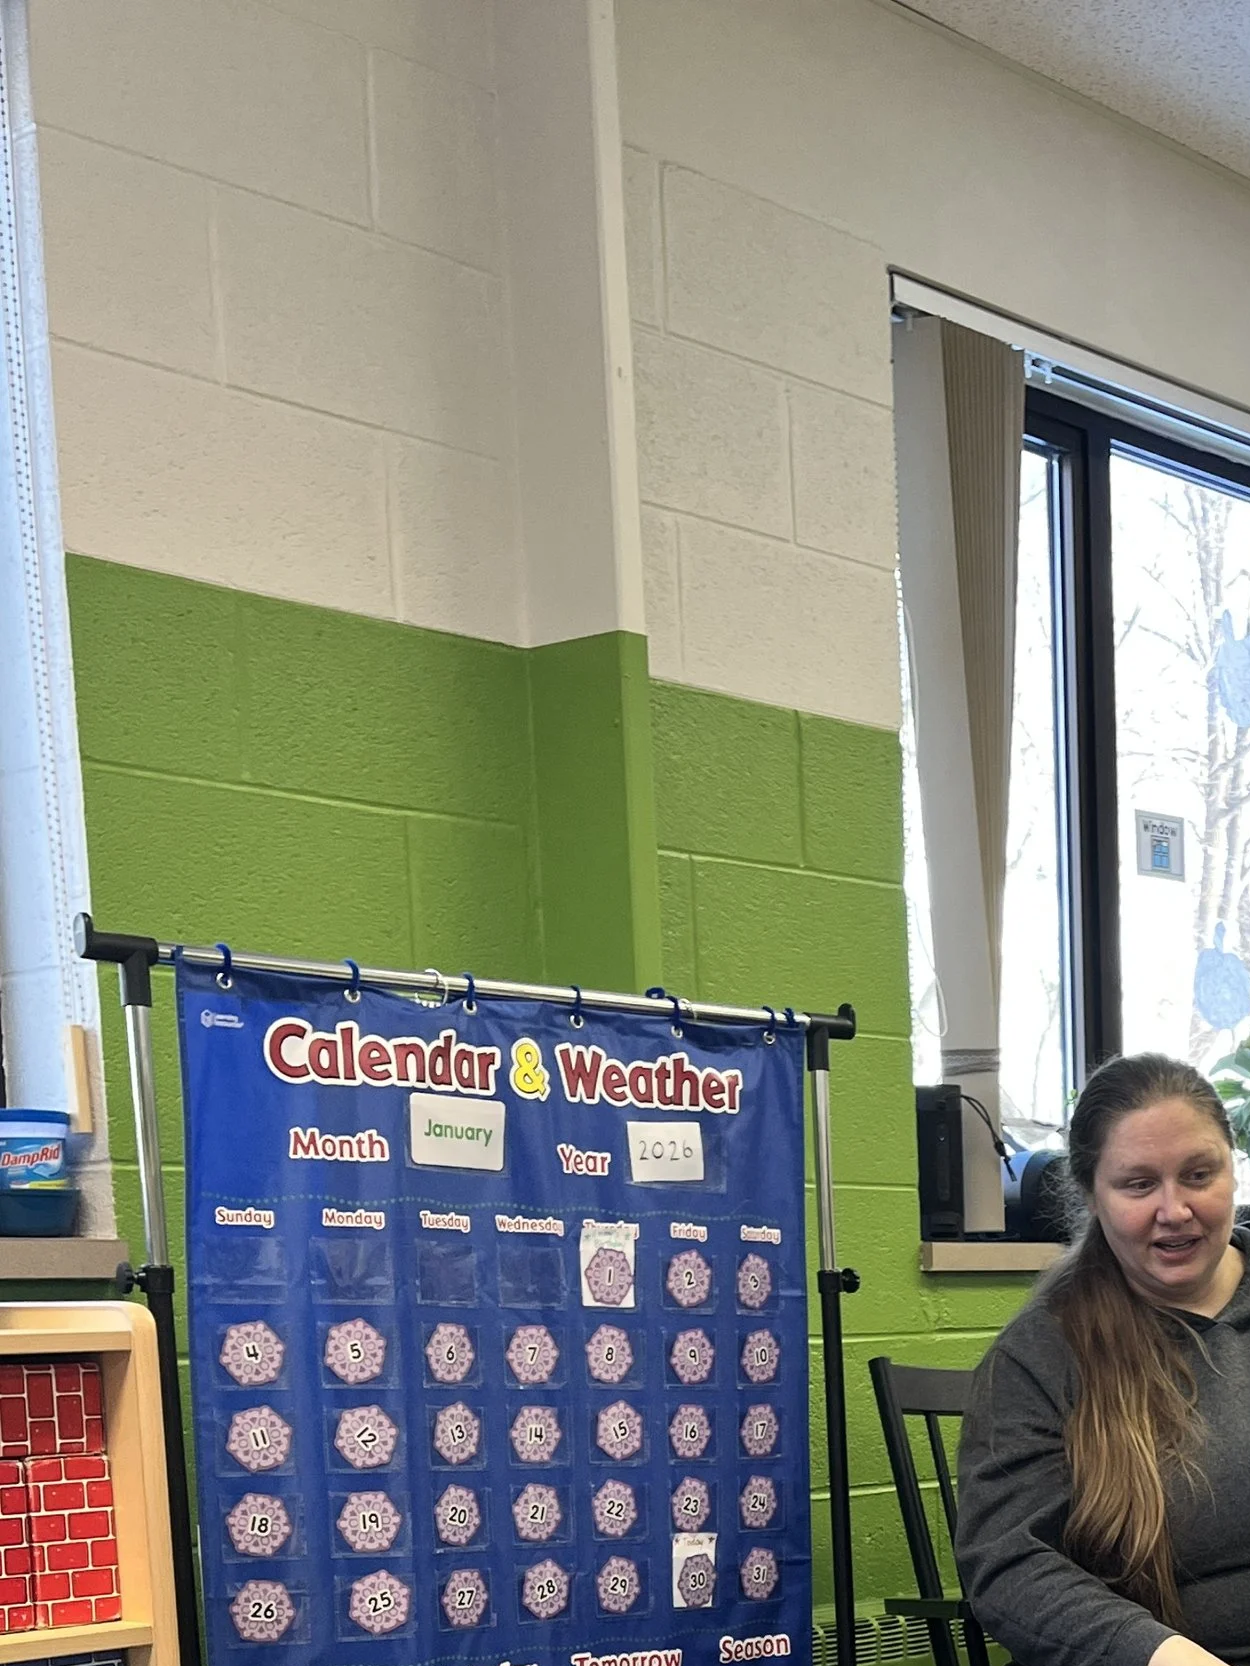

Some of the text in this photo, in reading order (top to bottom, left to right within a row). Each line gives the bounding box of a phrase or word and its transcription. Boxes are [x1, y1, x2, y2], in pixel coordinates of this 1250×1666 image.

[268, 1022, 740, 1111] Calendar & Weather
[291, 1129, 387, 1160] Month
[424, 1119, 493, 1147] January
[1, 1144, 60, 1167] DampRid
[560, 1147, 609, 1174] Year
[639, 1140, 693, 1161] 2026
[217, 1209, 272, 1227] Sunday
[323, 1211, 383, 1228] Monday
[421, 1213, 470, 1231] Tuesday
[496, 1217, 563, 1234] Wednesday
[673, 1224, 707, 1241] Friday
[607, 1270, 759, 1289] 1 2 3
[245, 1343, 767, 1364] 4 5 6 7 8 9 10
[252, 1421, 767, 1448] 11 12 13 14 15 16 17
[250, 1495, 766, 1534] 18 19 20 21 22 23 24
[250, 1566, 766, 1619] 26 25 27 28 29 30 31
[722, 1636, 789, 1662] Season
